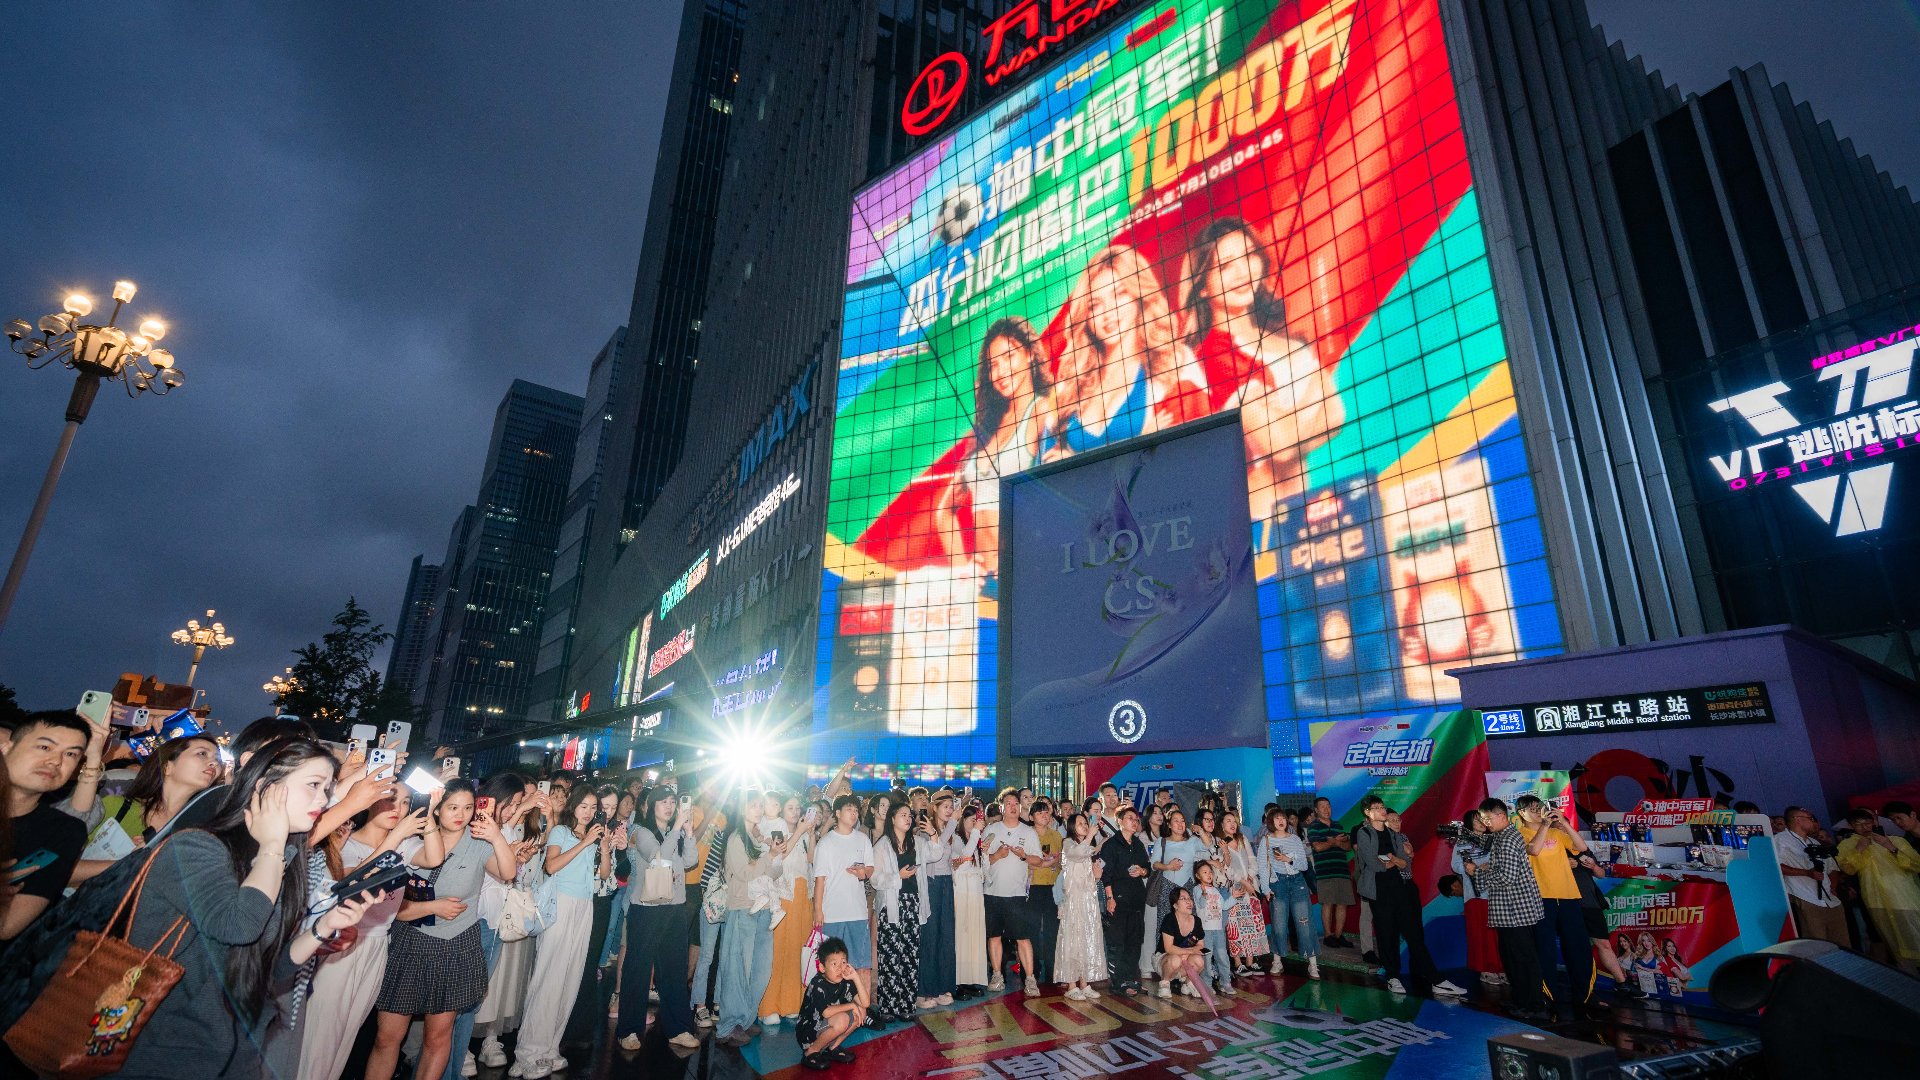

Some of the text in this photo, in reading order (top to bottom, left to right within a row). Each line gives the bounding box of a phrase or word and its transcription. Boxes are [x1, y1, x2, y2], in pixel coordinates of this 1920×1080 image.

[738, 361, 818, 488] IMAX
[1061, 515, 1195, 574] I LOVE
[1562, 695, 1690, 722] 湘江中路站
[1486, 712, 1521, 732] 2号线
[1565, 712, 1691, 730] Xiangjiang Middle Road station
[1344, 738, 1433, 765] 定点运球
[1654, 800, 1712, 812] 抽中冠军！
[1613, 891, 1677, 910] 抽中冠军！
[1605, 905, 1705, 927] 叨嘴巴1000万
